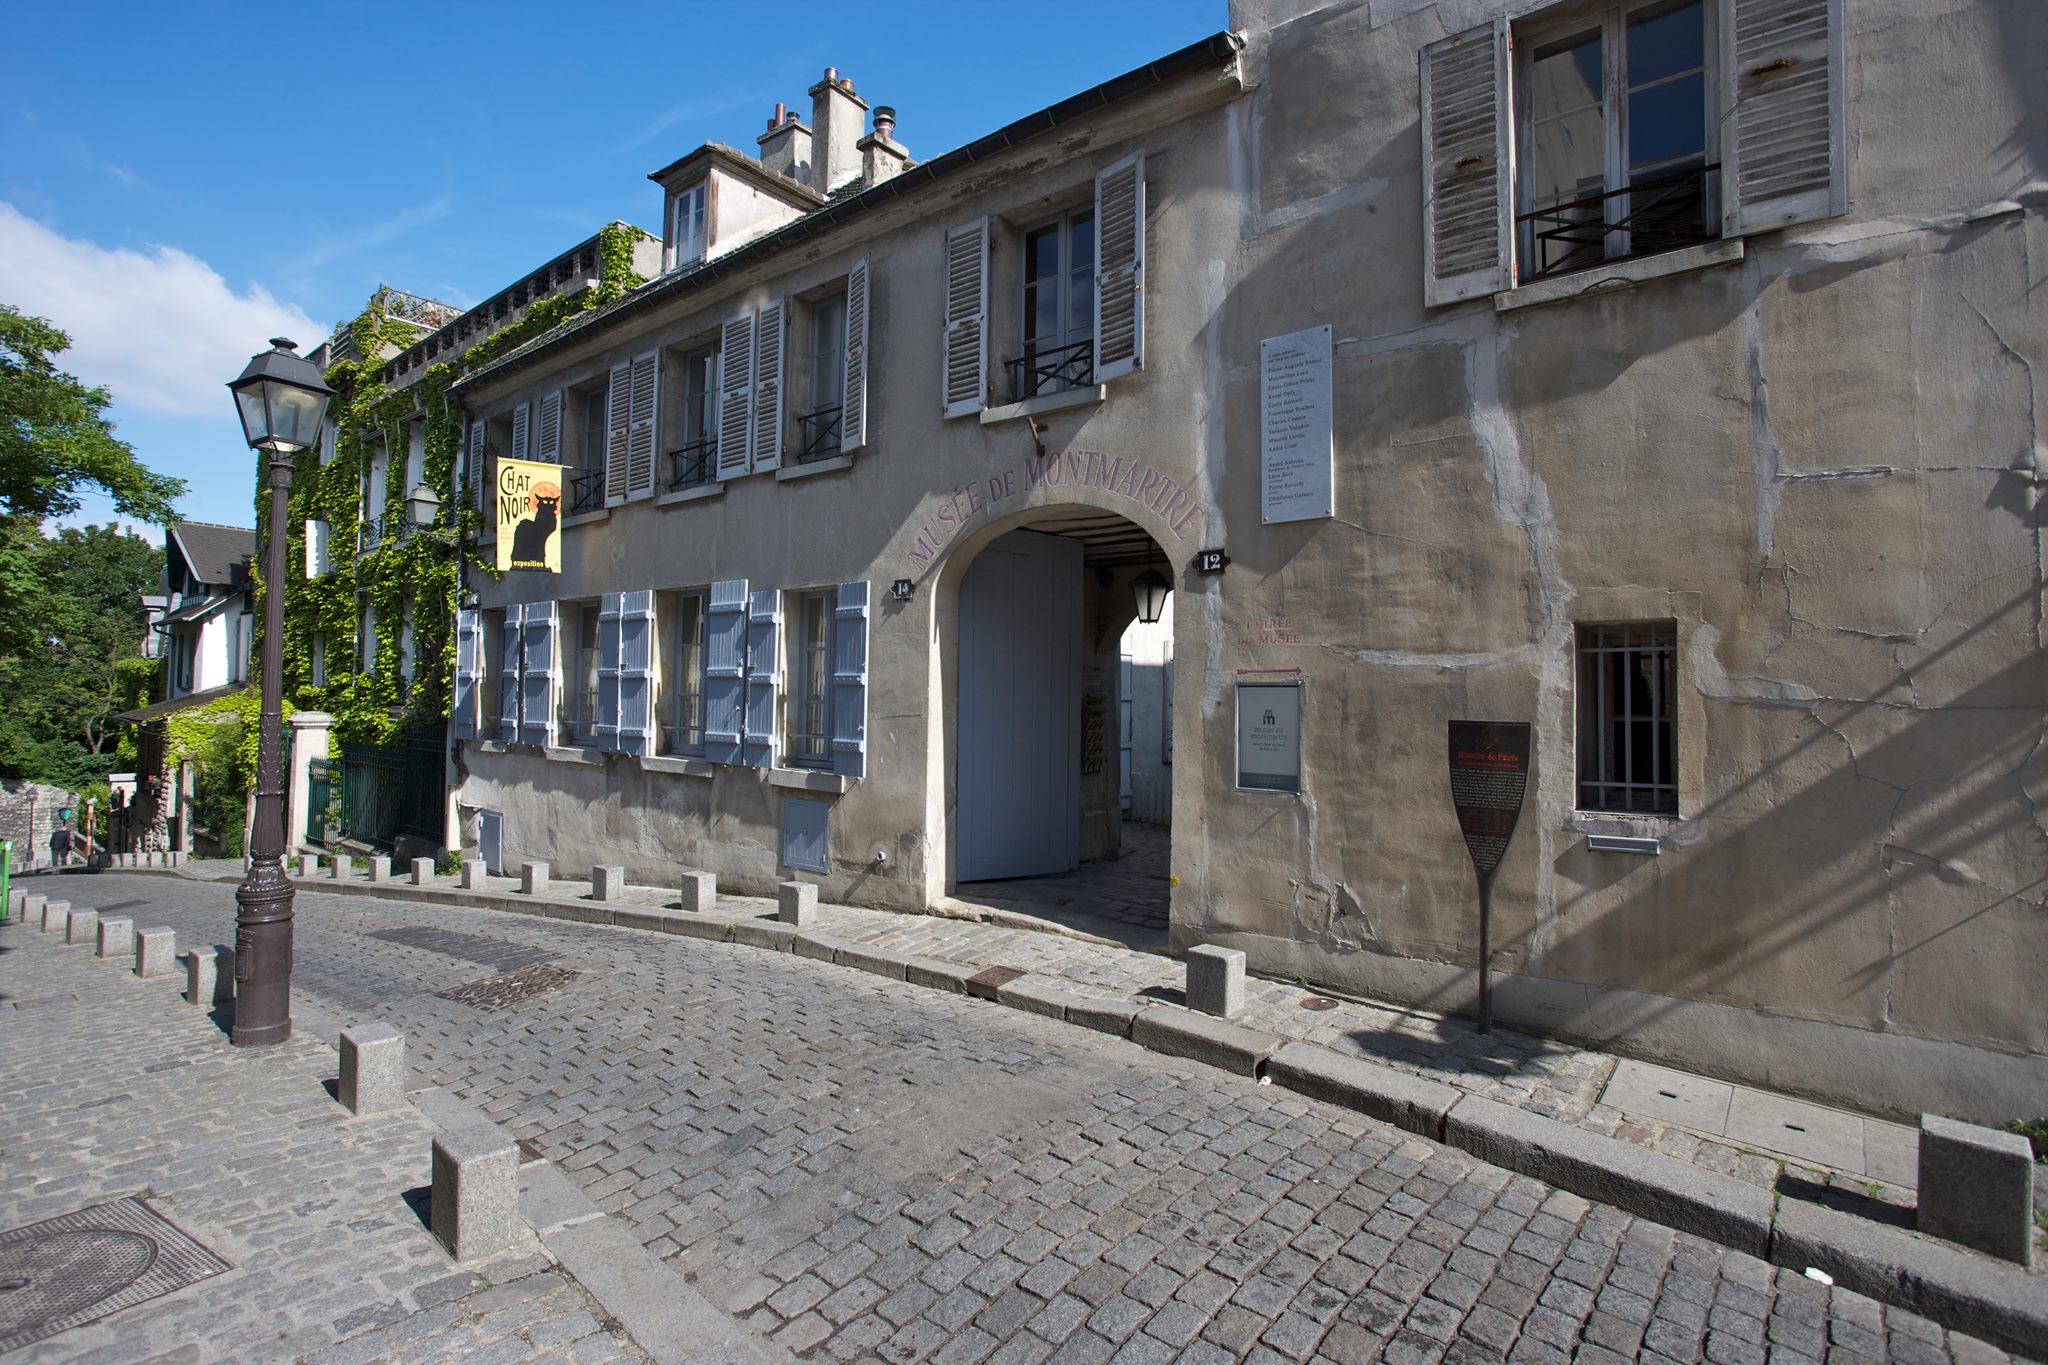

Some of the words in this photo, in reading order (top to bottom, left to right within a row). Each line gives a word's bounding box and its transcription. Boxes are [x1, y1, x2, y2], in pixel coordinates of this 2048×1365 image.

[500, 466, 530, 495] CHAT
[500, 496, 530, 524] NOIR
[908, 480, 983, 570] MUSÉE
[988, 470, 1016, 504] DE
[1024, 451, 1204, 540] MONTMARTRE
[513, 560, 545, 568] exposition
[1202, 553, 1220, 570] 12
[898, 583, 909, 594] 14
